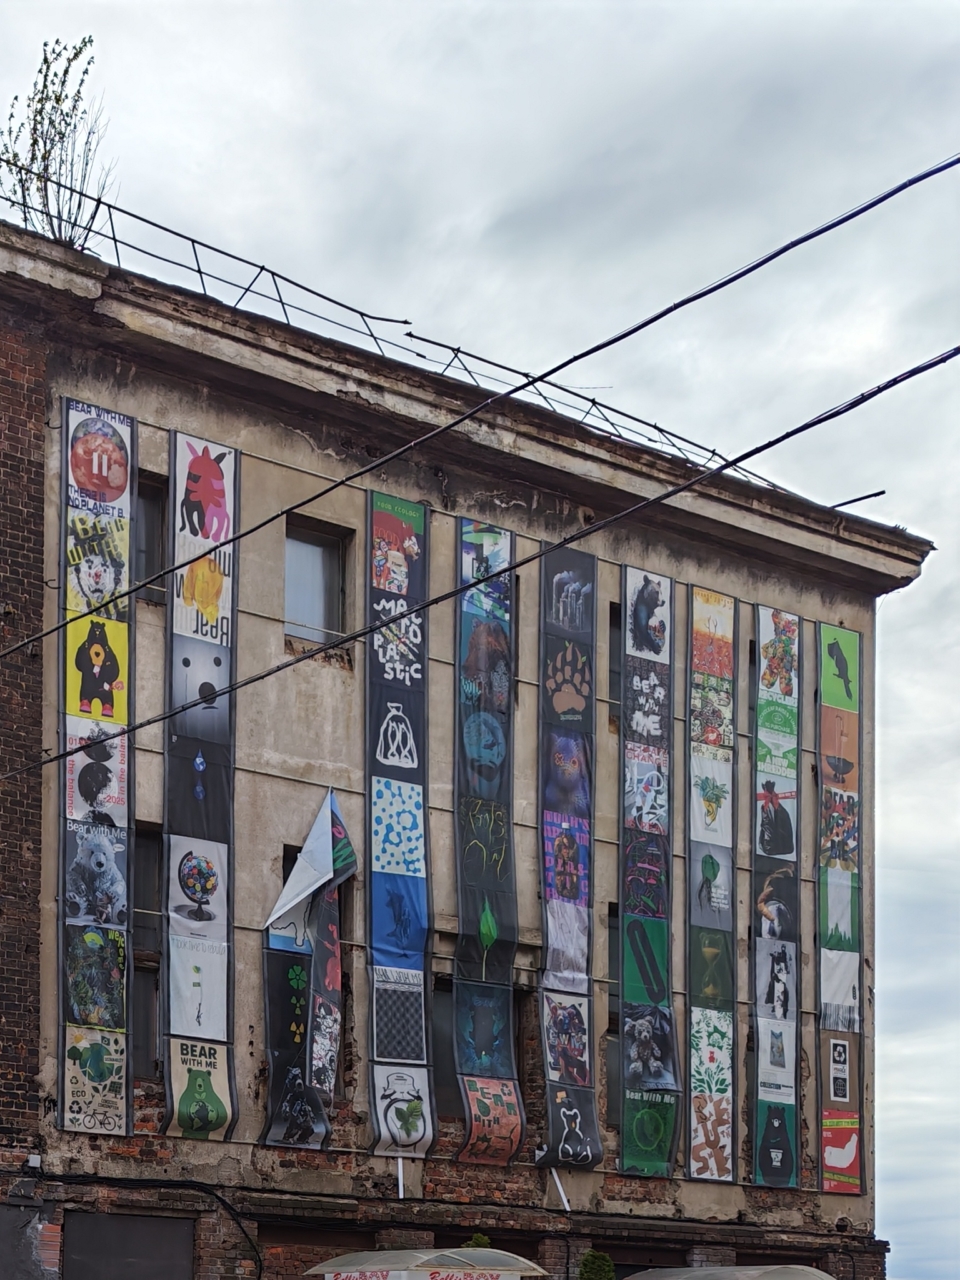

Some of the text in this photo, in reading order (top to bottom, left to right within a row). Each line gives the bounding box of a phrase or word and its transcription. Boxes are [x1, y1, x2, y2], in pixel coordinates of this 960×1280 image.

[69, 400, 132, 428] BEAR WITH ME
[68, 483, 97, 501] THERE
[80, 500, 116, 518] PLANET
[67, 777, 75, 817] balance
[67, 820, 127, 840] Bear with Me
[180, 1042, 217, 1060] BEAR
[181, 1057, 218, 1070] WITH ME
[71, 1090, 87, 1098] ECO
